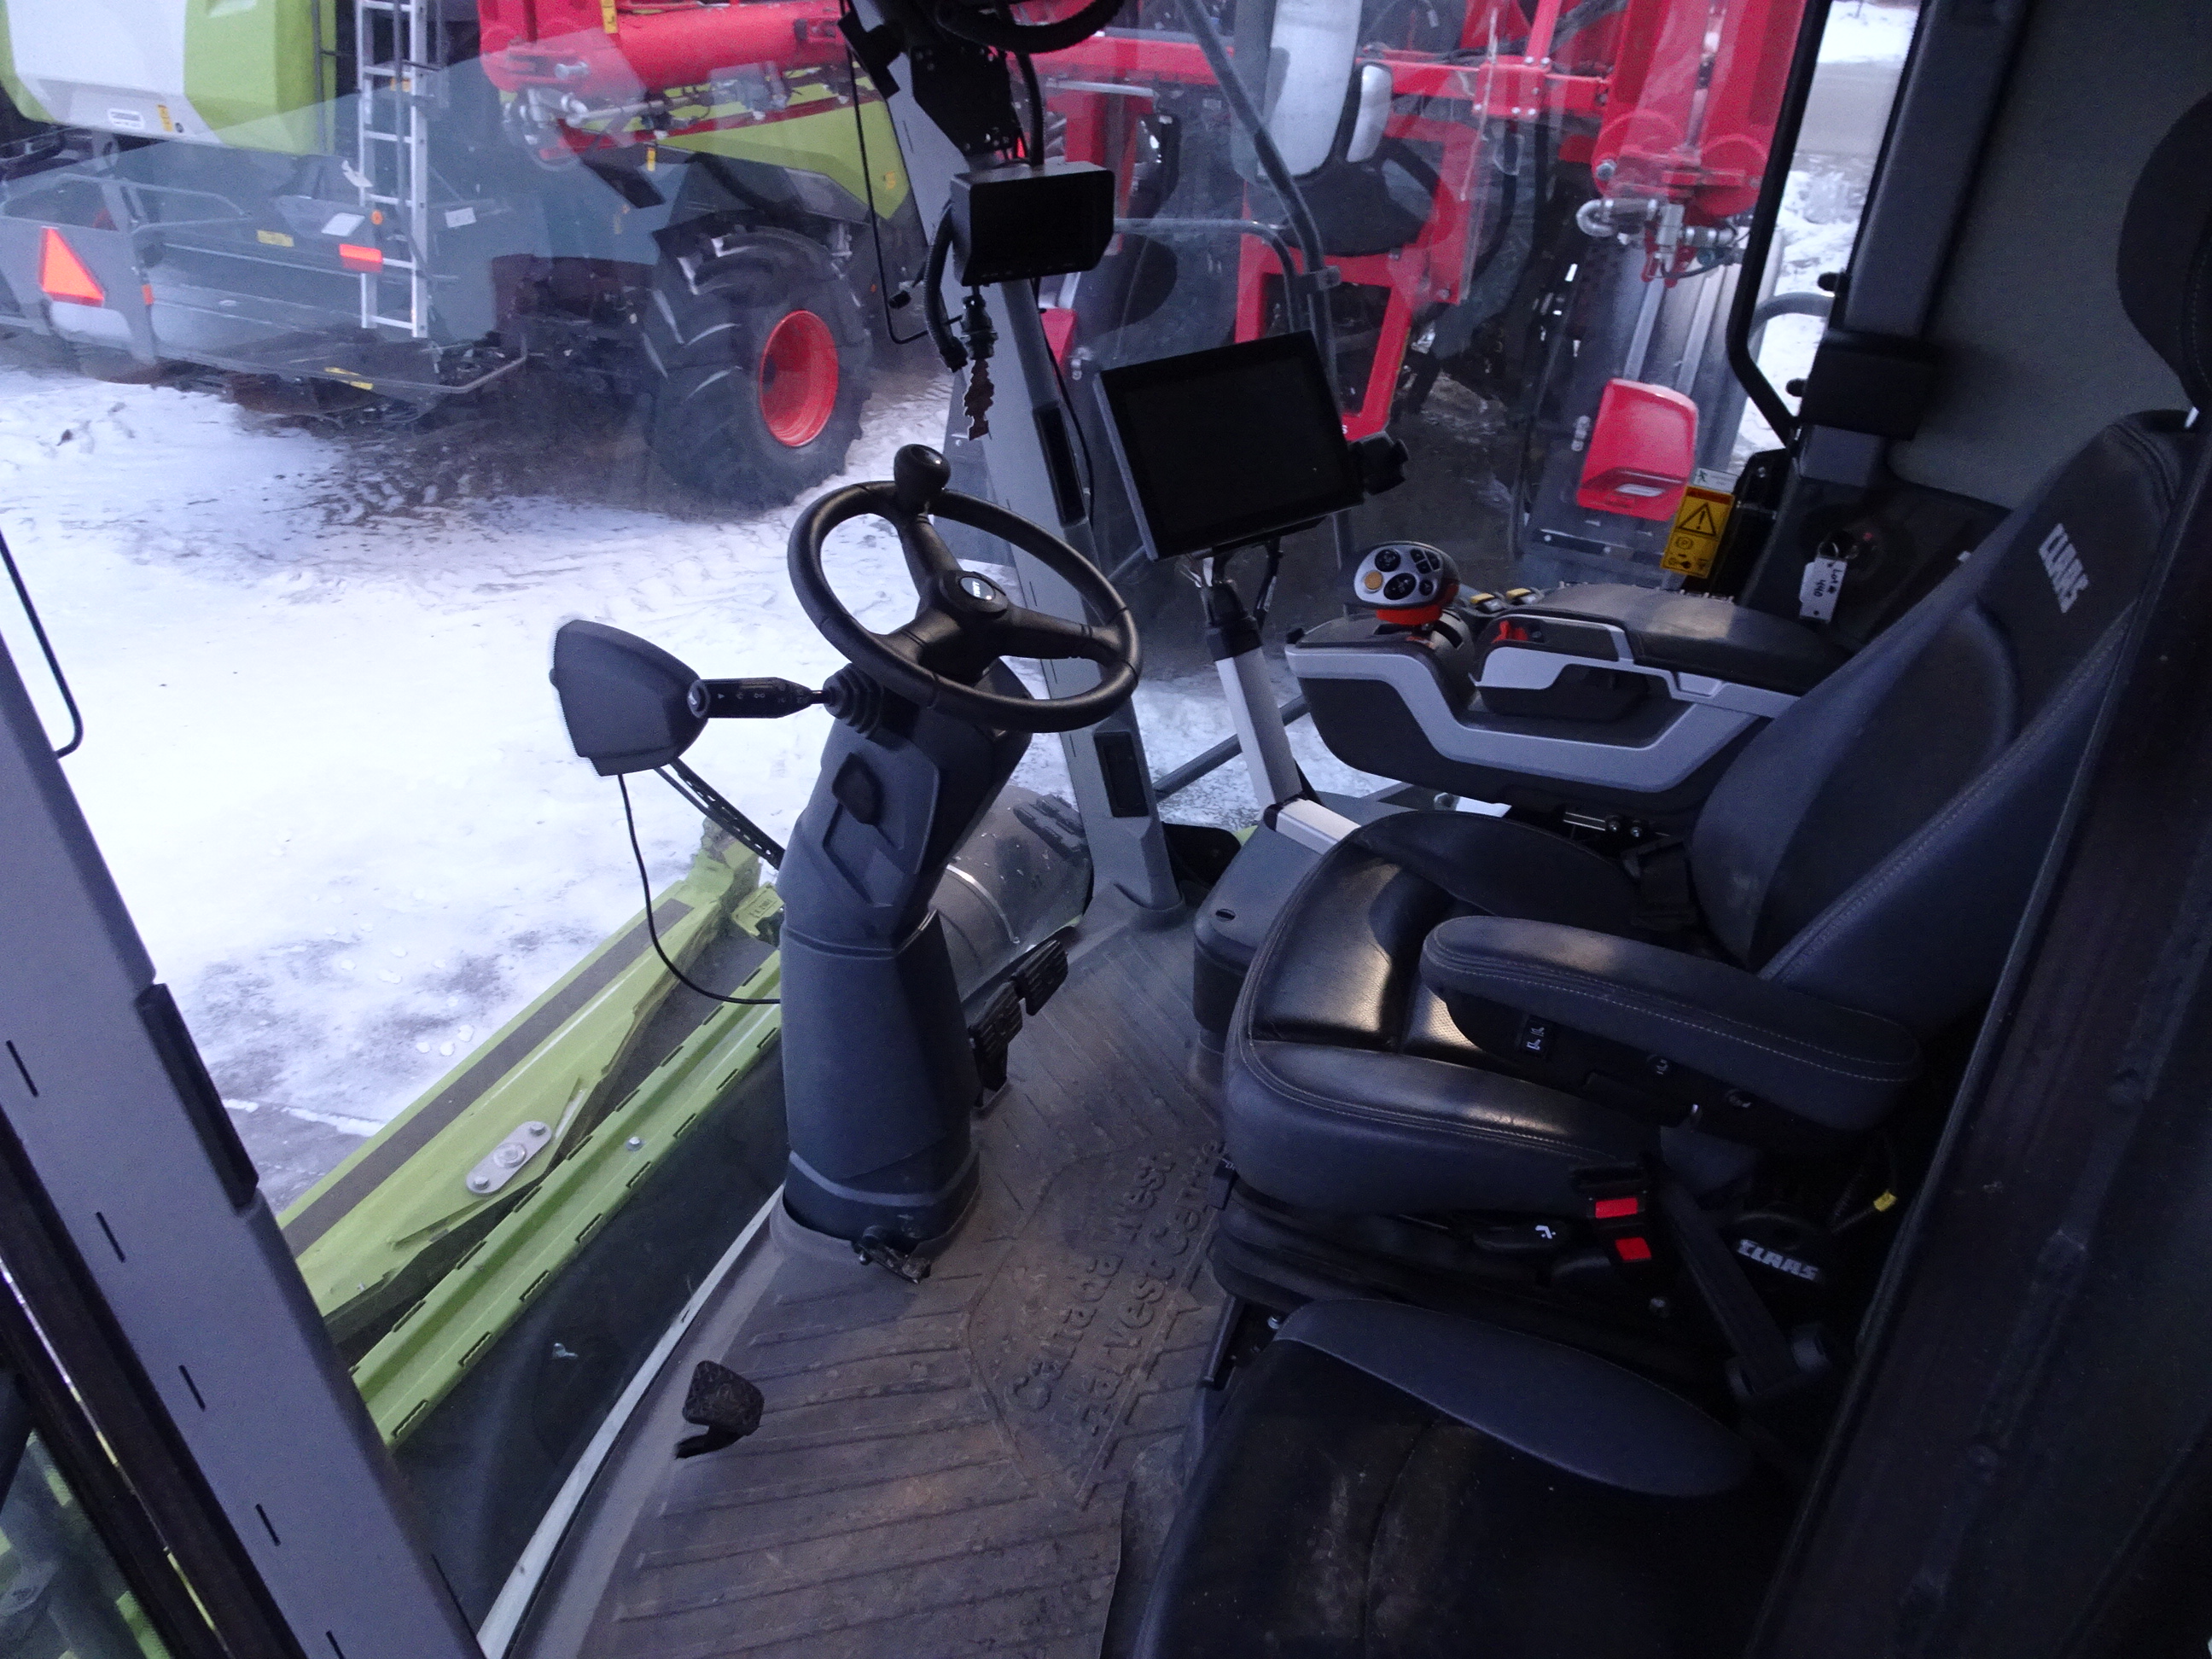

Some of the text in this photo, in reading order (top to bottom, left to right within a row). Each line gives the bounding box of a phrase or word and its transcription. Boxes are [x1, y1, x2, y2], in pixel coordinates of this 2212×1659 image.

[1831, 568, 1843, 584] Lot
[2039, 522, 2088, 613] CLAAS
[1813, 579, 1826, 597] 440
[1737, 1238, 1819, 1282] CLAAS
